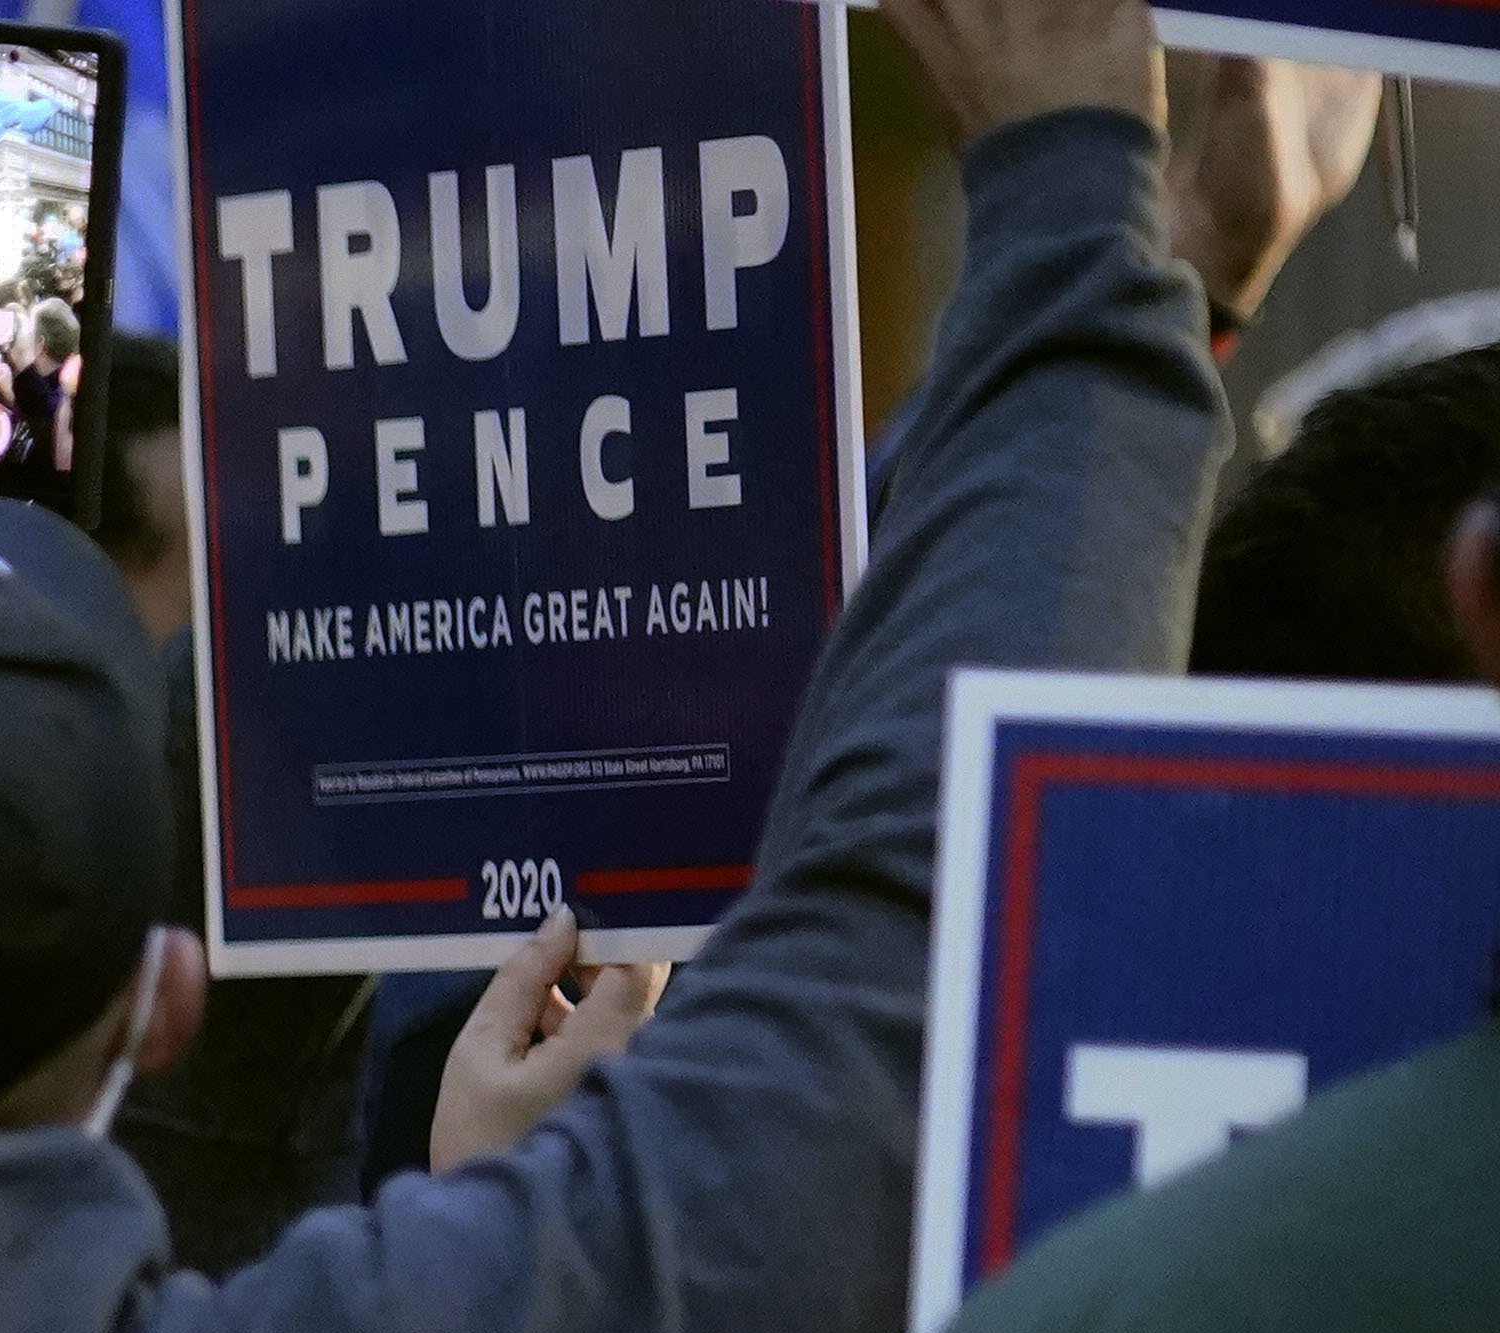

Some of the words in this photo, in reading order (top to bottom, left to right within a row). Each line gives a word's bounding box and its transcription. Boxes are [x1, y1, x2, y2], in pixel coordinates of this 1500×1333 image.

[217, 134, 791, 380] TRUMP
[277, 388, 746, 545] PENCE
[266, 606, 355, 666] MAKE
[365, 594, 513, 658] AMERICA
[523, 584, 631, 644] GREAT
[645, 576, 770, 637] AGAIN!
[481, 857, 563, 919] 2020
